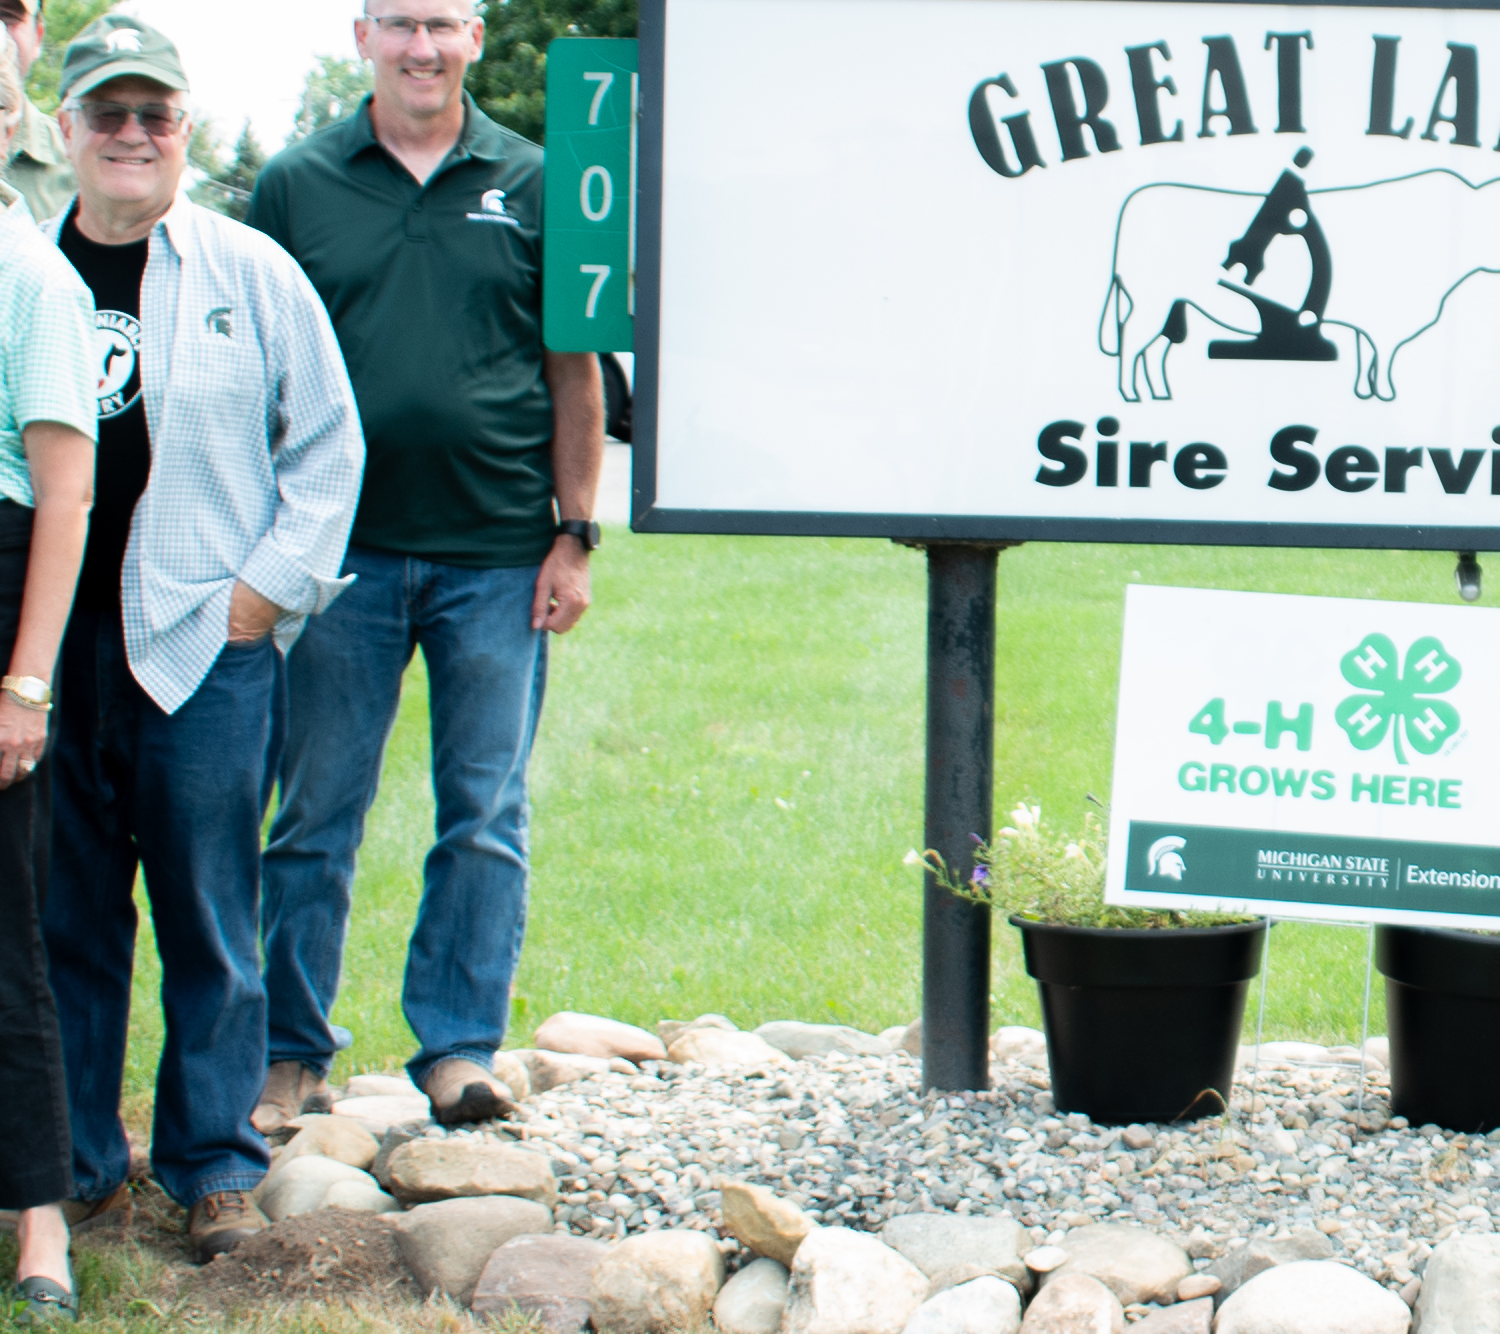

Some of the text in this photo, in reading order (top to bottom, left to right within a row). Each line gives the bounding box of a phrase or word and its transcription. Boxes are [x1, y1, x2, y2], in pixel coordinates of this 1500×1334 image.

[967, 30, 1313, 179] GREAT
[1035, 417, 1228, 490] Sire
[1187, 697, 1315, 752] 4-H
[1177, 761, 1463, 809] GROWS HERE
[1256, 868, 1389, 889] UNIVERSITY
[1257, 849, 1390, 873] MICHIGAN STATE
